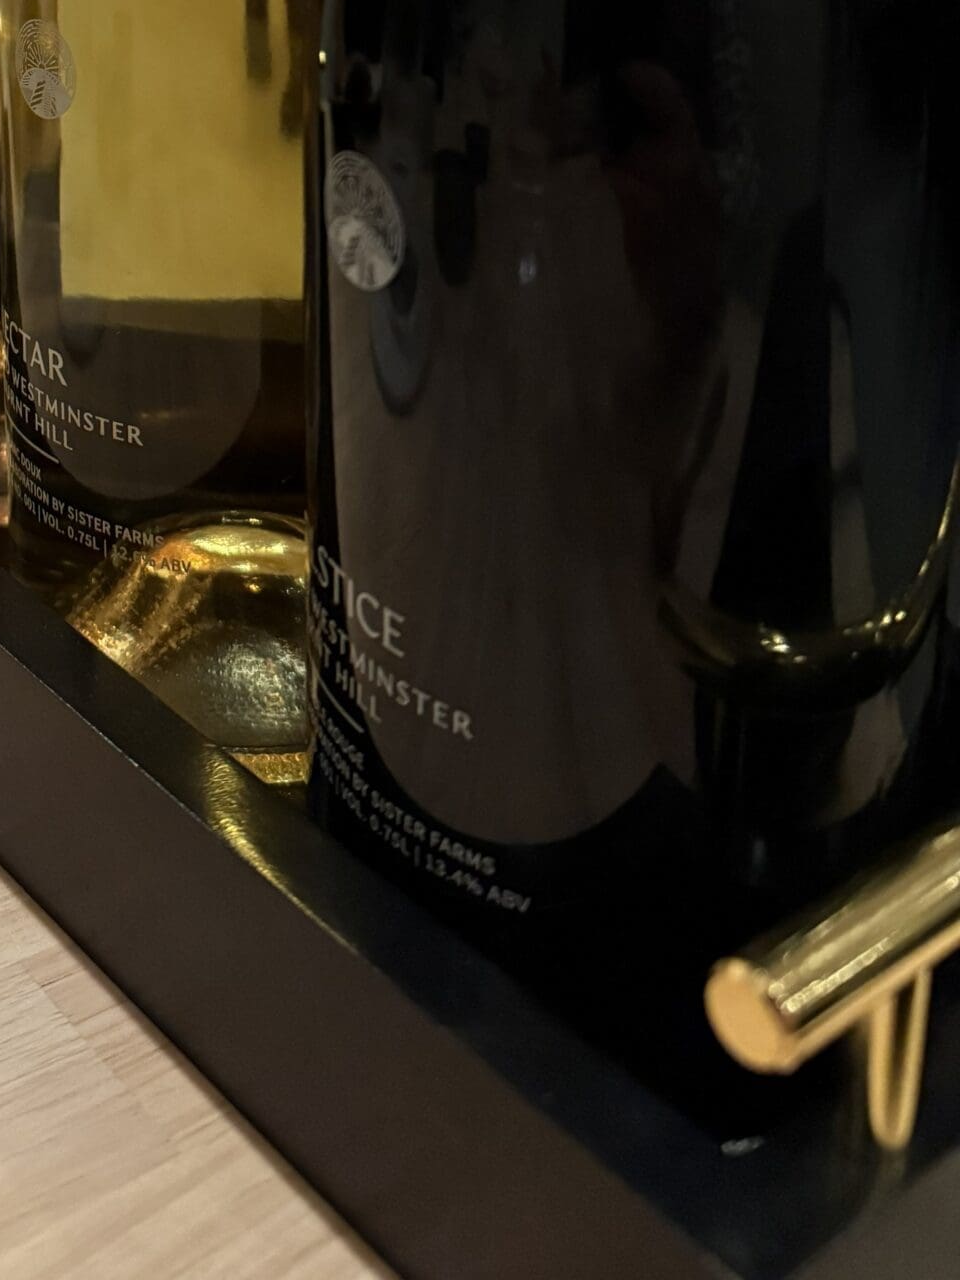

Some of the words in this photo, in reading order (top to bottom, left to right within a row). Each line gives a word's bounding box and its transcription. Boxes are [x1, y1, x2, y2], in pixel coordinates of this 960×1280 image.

[3, 310, 68, 387] ECTAR
[12, 365, 144, 447] WESTMINSTER
[35, 413, 73, 451] HILL
[42, 510, 65, 535] VOL.
[67, 527, 100, 552] 0.75L
[51, 496, 66, 516] BY
[68, 507, 111, 536] SISTER
[114, 524, 165, 549] FARMS
[335, 660, 382, 724] HILL
[371, 789, 426, 842] SISTER
[429, 830, 497, 876] FARMS
